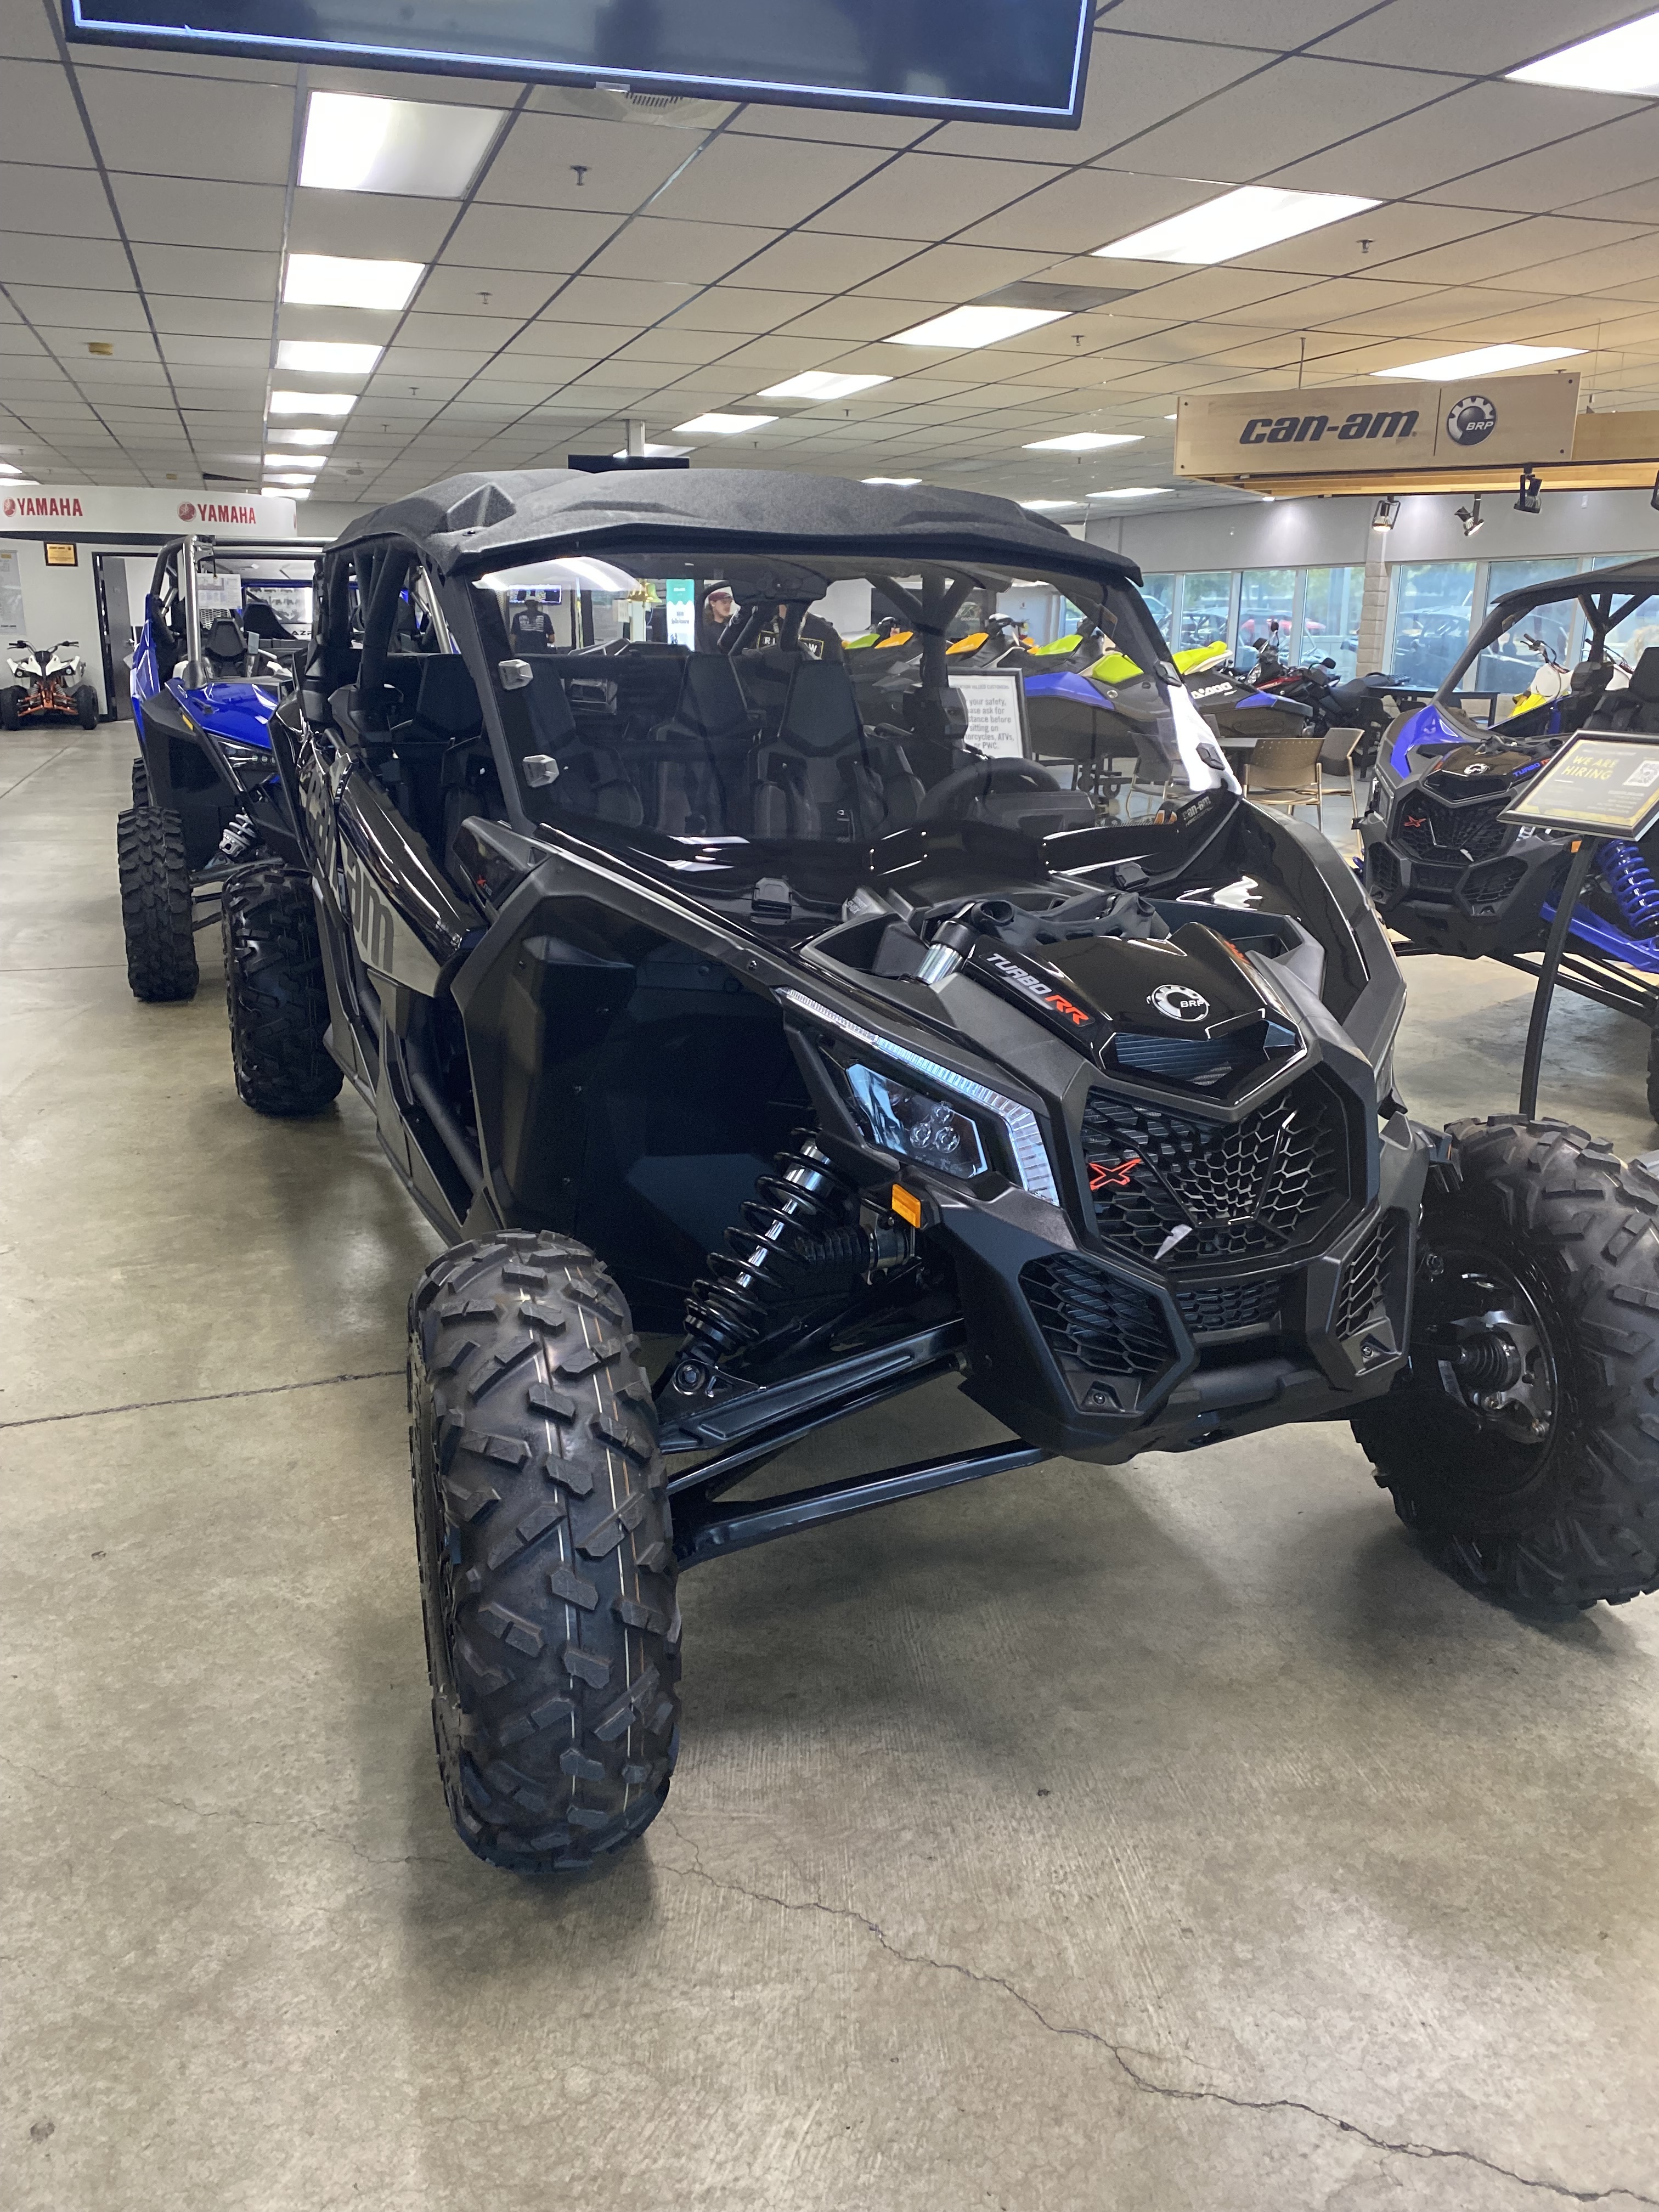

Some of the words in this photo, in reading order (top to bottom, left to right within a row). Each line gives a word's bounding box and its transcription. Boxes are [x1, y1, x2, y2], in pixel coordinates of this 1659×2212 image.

[1239, 410, 1420, 445] can-am
[1465, 420, 1494, 431] BRP
[16, 498, 83, 516] YAMAHA
[197, 504, 256, 524] YAMAHA
[969, 698, 984, 707] your
[985, 697, 1007, 707] safety,
[995, 706, 1005, 715] for
[990, 715, 1012, 723] before
[969, 725, 989, 733] sitting
[965, 733, 997, 742] torcycles,
[997, 732, 1014, 742] ATVs,
[1572, 755, 1594, 765] WE
[1592, 758, 1620, 768] ARE
[1513, 762, 1541, 777] TURBO
[1561, 765, 1614, 780] HIRING
[986, 953, 1052, 995] TURBO
[1044, 994, 1089, 1025] RR
